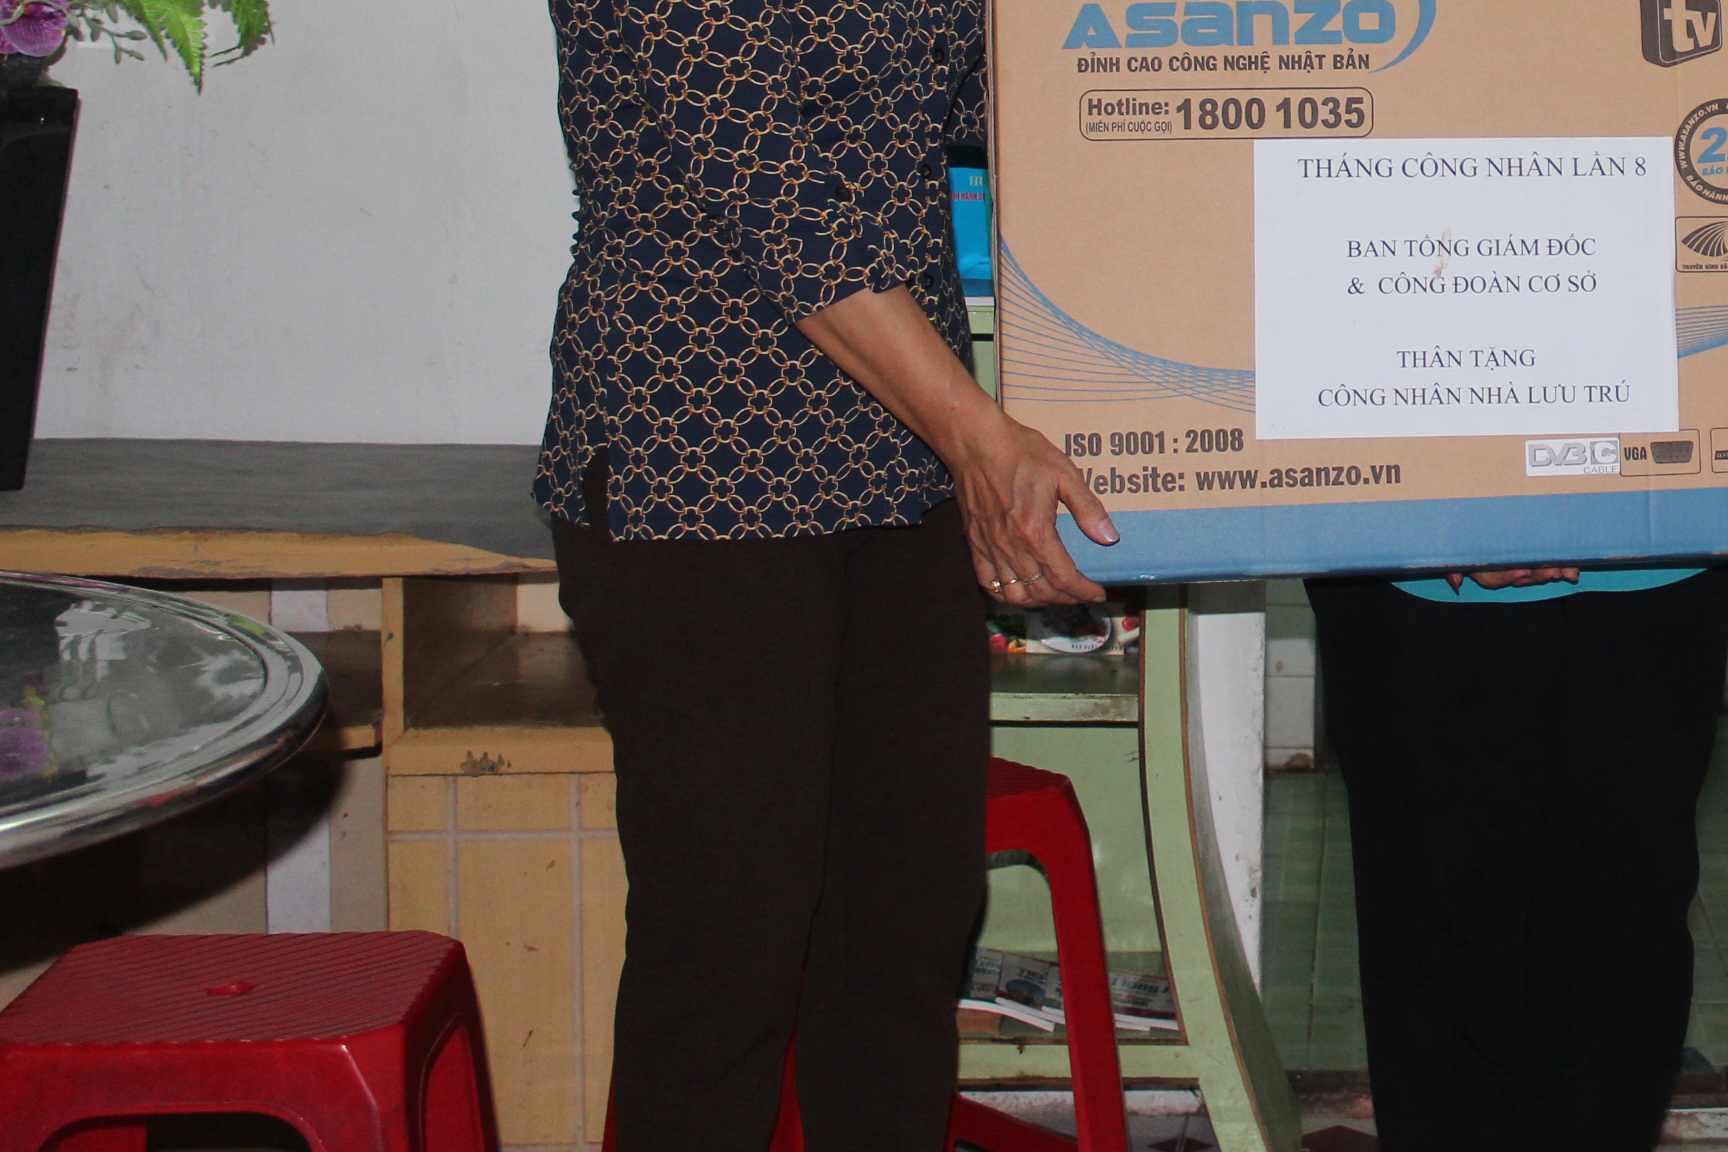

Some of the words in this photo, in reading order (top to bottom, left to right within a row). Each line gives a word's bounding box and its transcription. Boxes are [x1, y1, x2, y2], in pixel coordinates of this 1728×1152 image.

[1077, 52, 1120, 73] ĐỈNH
[1127, 56, 1162, 72] CAO
[1169, 52, 1217, 72] CÔNG
[1223, 51, 1271, 73] NGHỆ
[1279, 51, 1326, 73] NHẬT
[1333, 48, 1370, 70] BẢN
[1087, 98, 1170, 116] Hotline:
[1176, 97, 1266, 130] 1800
[1275, 96, 1365, 129] 1035
[1127, 120, 1152, 134] CUỘC
[1154, 120, 1173, 135] GỌI)
[1678, 103, 1719, 169] WWW.ASANZO.VN
[1697, 126, 1728, 164] 2
[1298, 153, 1393, 178] THÁNG
[1401, 152, 1478, 178] CÔNG
[1486, 152, 1564, 177] NHÂN
[1571, 150, 1627, 177] LẦN
[1634, 157, 1647, 177] 8
[1686, 174, 1703, 190] BẢO
[1702, 188, 1728, 201] HÀNH
[1348, 240, 1397, 258] BAN
[1404, 234, 1470, 258] TỔNG
[1477, 234, 1539, 257] GIÁM
[1546, 233, 1596, 257] ĐỐC
[1348, 278, 1365, 295] &
[1378, 272, 1446, 295] CÔNG
[1452, 271, 1521, 294] ĐOÀN
[1528, 274, 1561, 294] CƠ
[1568, 270, 1597, 293] SỞ
[1397, 345, 1462, 368] THÂN
[1470, 345, 1536, 371] TẶNG
[1318, 383, 1386, 407] CÔNG
[1394, 382, 1461, 406] NHÂN
[1469, 382, 1520, 405] NHÀ
[1527, 383, 1576, 404] LƯU
[1584, 379, 1630, 403] TRÚ
[1065, 433, 1102, 457] ISO
[1110, 431, 1165, 456] 9001
[1185, 428, 1244, 453] 2008
[1528, 441, 1588, 467] DVB
[1591, 440, 1618, 465] C
[1624, 447, 1647, 461] VGA
[1196, 464, 1401, 491] www.asanzo.vn
[1583, 466, 1619, 474] CABLE
